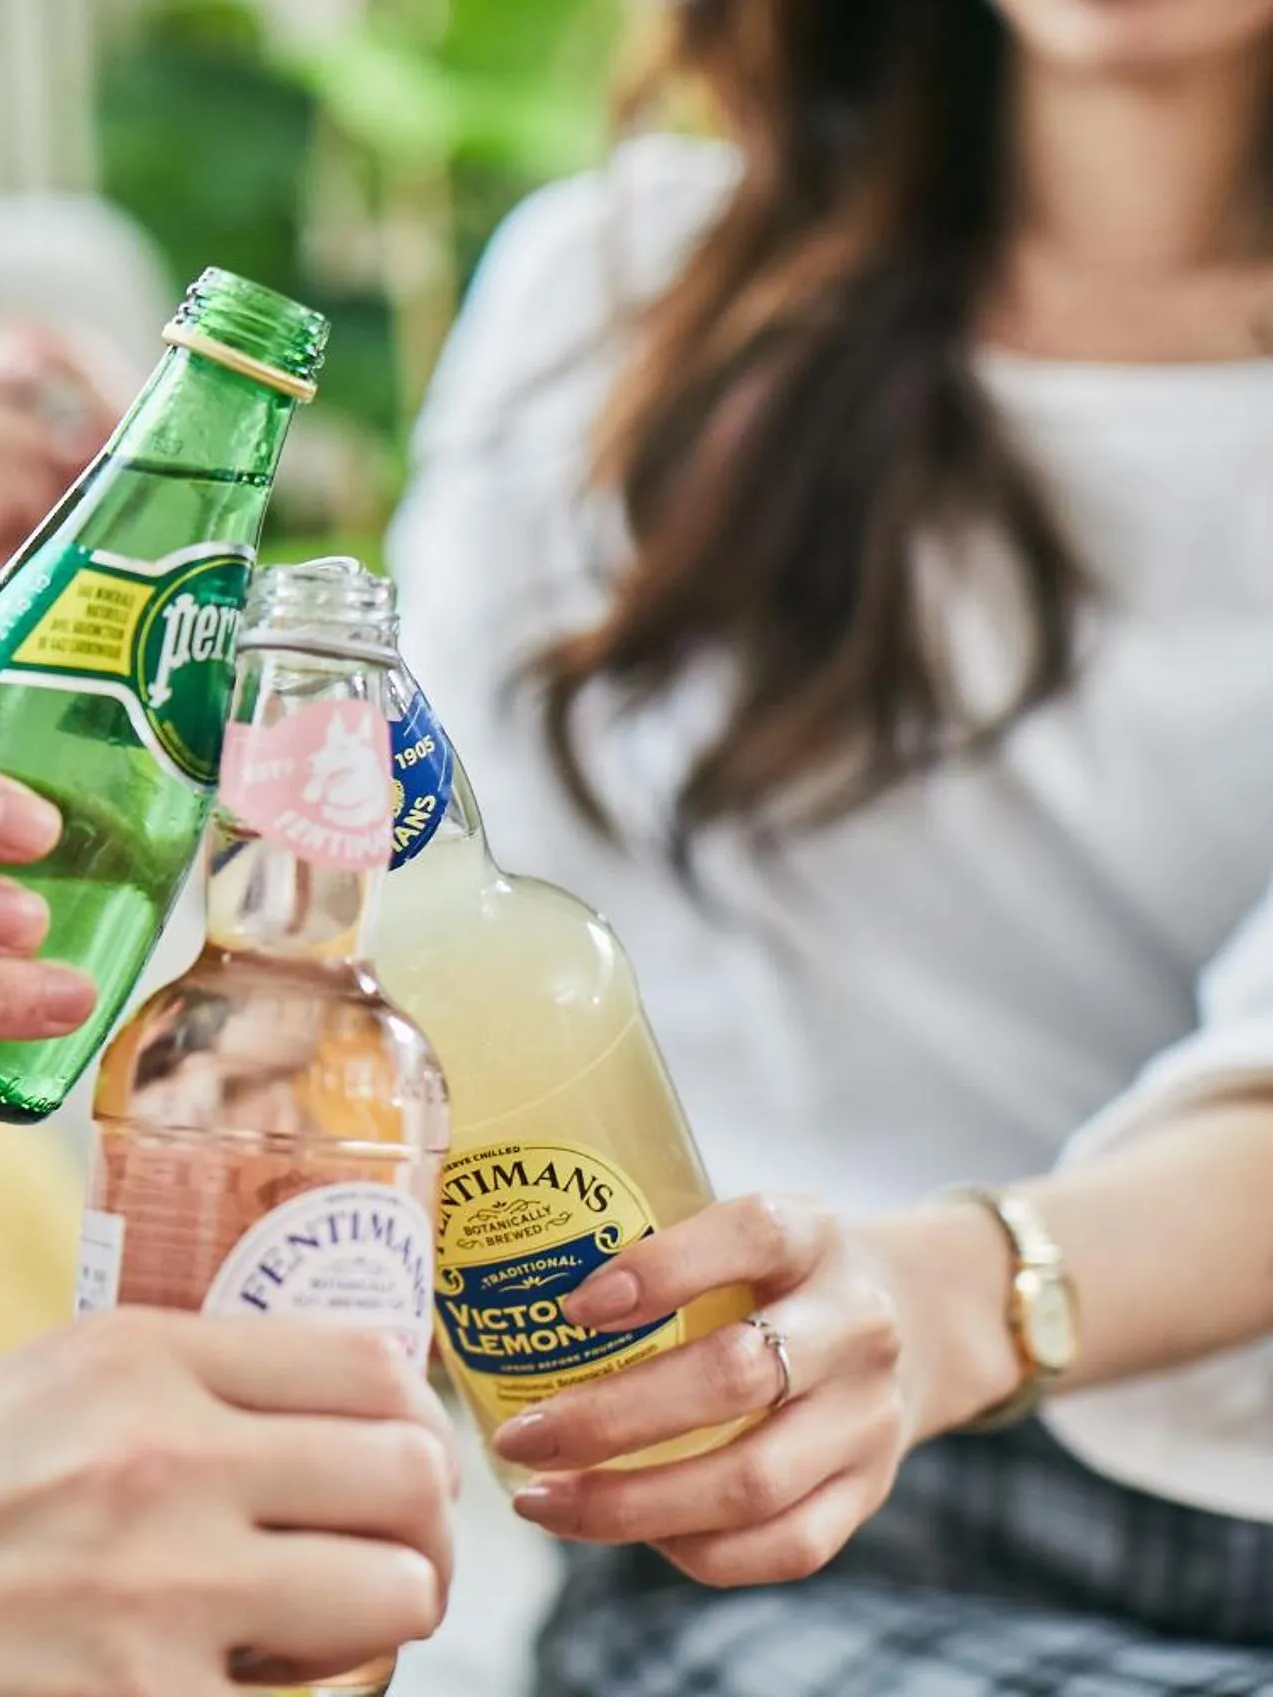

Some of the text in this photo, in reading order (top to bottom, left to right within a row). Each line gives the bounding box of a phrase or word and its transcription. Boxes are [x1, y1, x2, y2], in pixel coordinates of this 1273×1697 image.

[395, 736, 435, 769] 1905
[473, 1145, 521, 1162] CHILLED
[438, 1160, 614, 1256] NTIMANS
[463, 1204, 552, 1237] BOTANICALLY
[485, 1223, 543, 1247] BREWED
[485, 1256, 577, 1287] TRADITIONAL
[456, 1322, 599, 1357] LEMON
